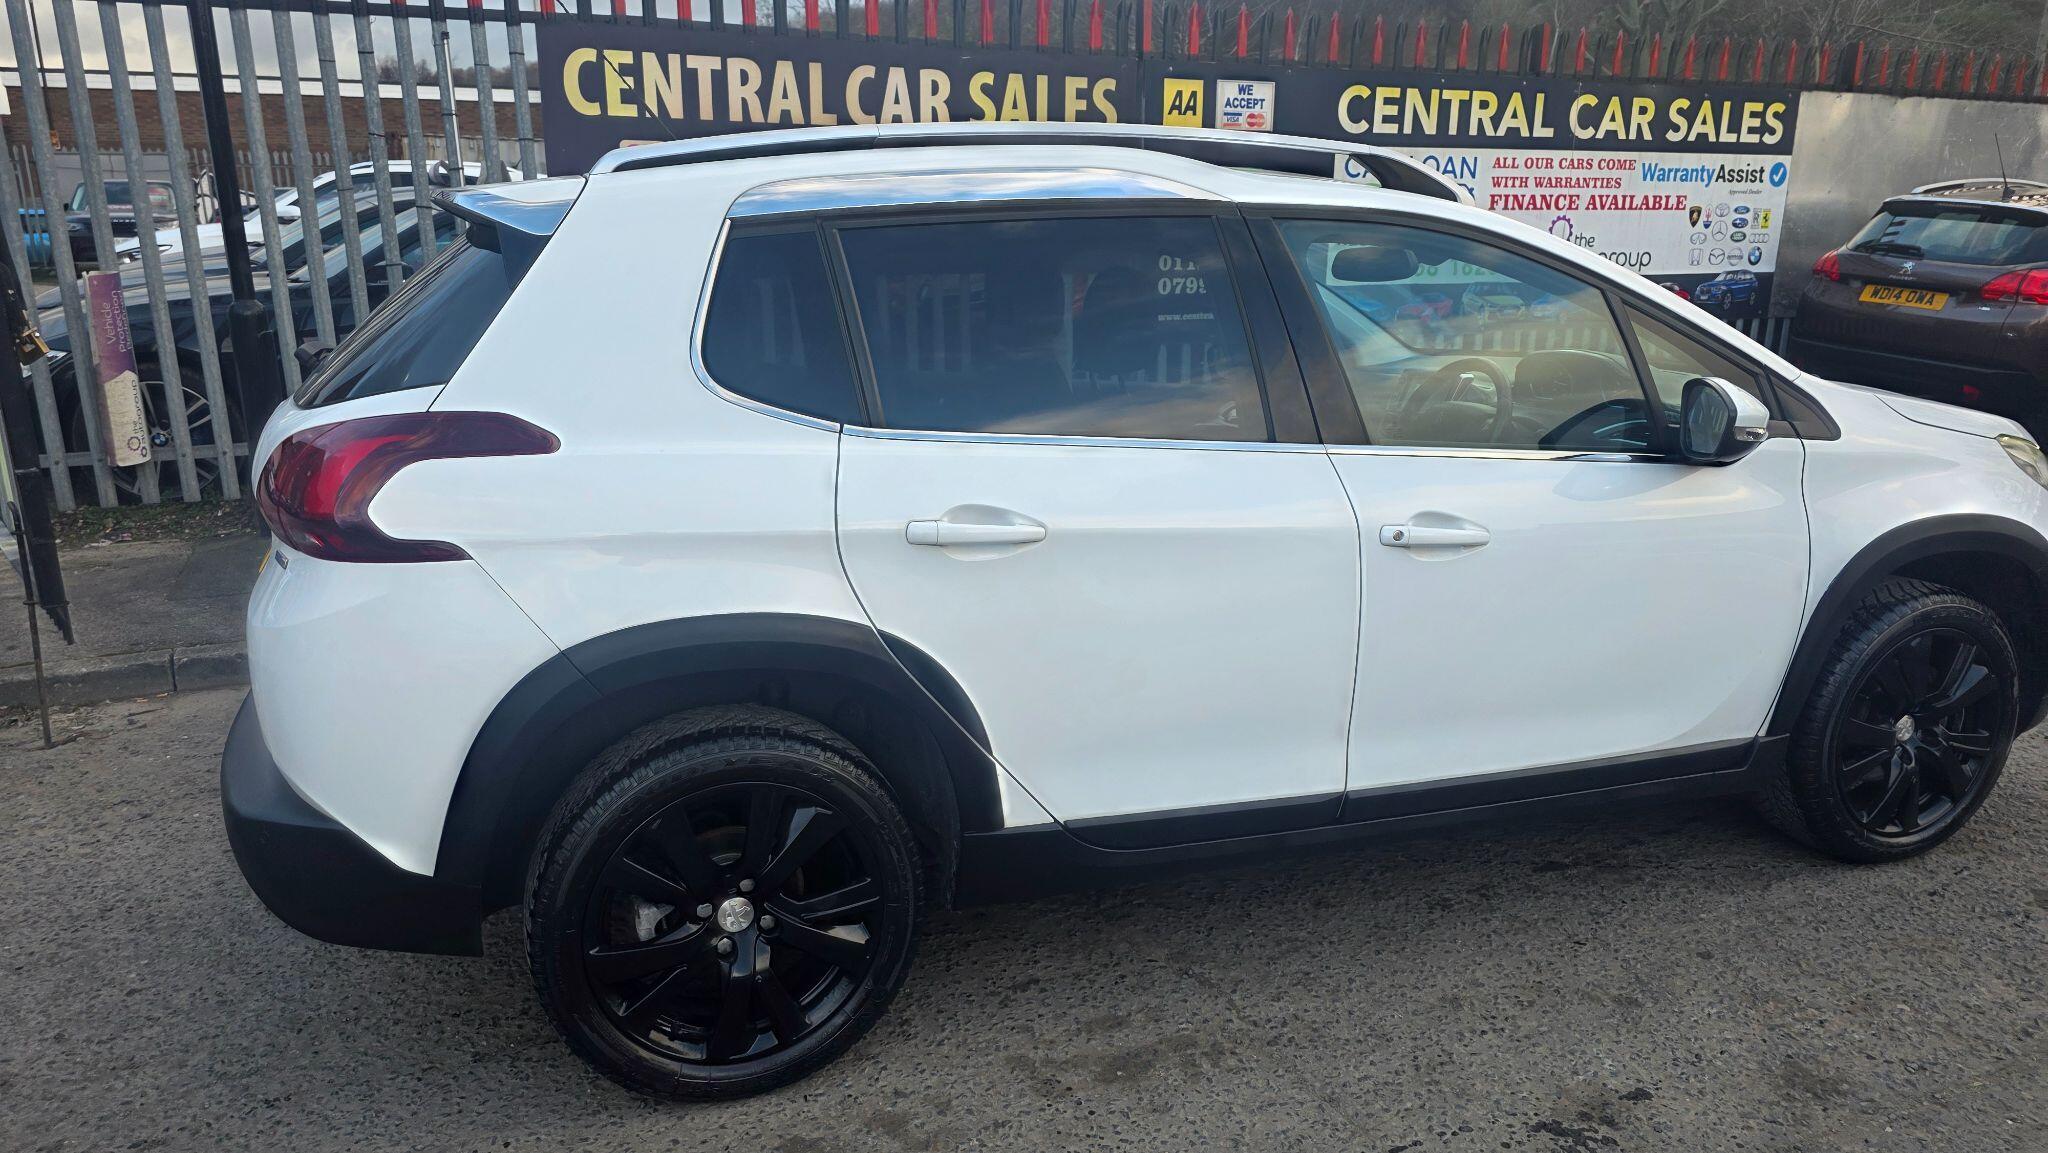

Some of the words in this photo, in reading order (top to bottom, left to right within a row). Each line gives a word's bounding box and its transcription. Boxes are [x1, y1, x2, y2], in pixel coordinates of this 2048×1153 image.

[563, 47, 838, 125] CENTRAL
[845, 64, 951, 124] CAR
[1237, 83, 1254, 96] WE
[1167, 89, 1198, 116] AA
[1224, 97, 1265, 110] ACCEPT
[1337, 84, 1555, 138] CENTRAL
[1568, 93, 1656, 140] CAR
[1665, 97, 1787, 145] SALES
[1492, 156, 1519, 169] ALL
[1524, 157, 1555, 170] OUR
[1558, 158, 1594, 170] CARS
[1597, 158, 1637, 171] COME
[1491, 176, 1530, 188] WITH
[1533, 177, 1622, 189] WARRANTIES
[1487, 193, 1581, 211] FINANCE
[1585, 194, 1688, 211] AVAILABLE
[1574, 232, 1596, 248] the
[1869, 286, 1903, 300] WD14
[1906, 290, 1936, 306] OWA
